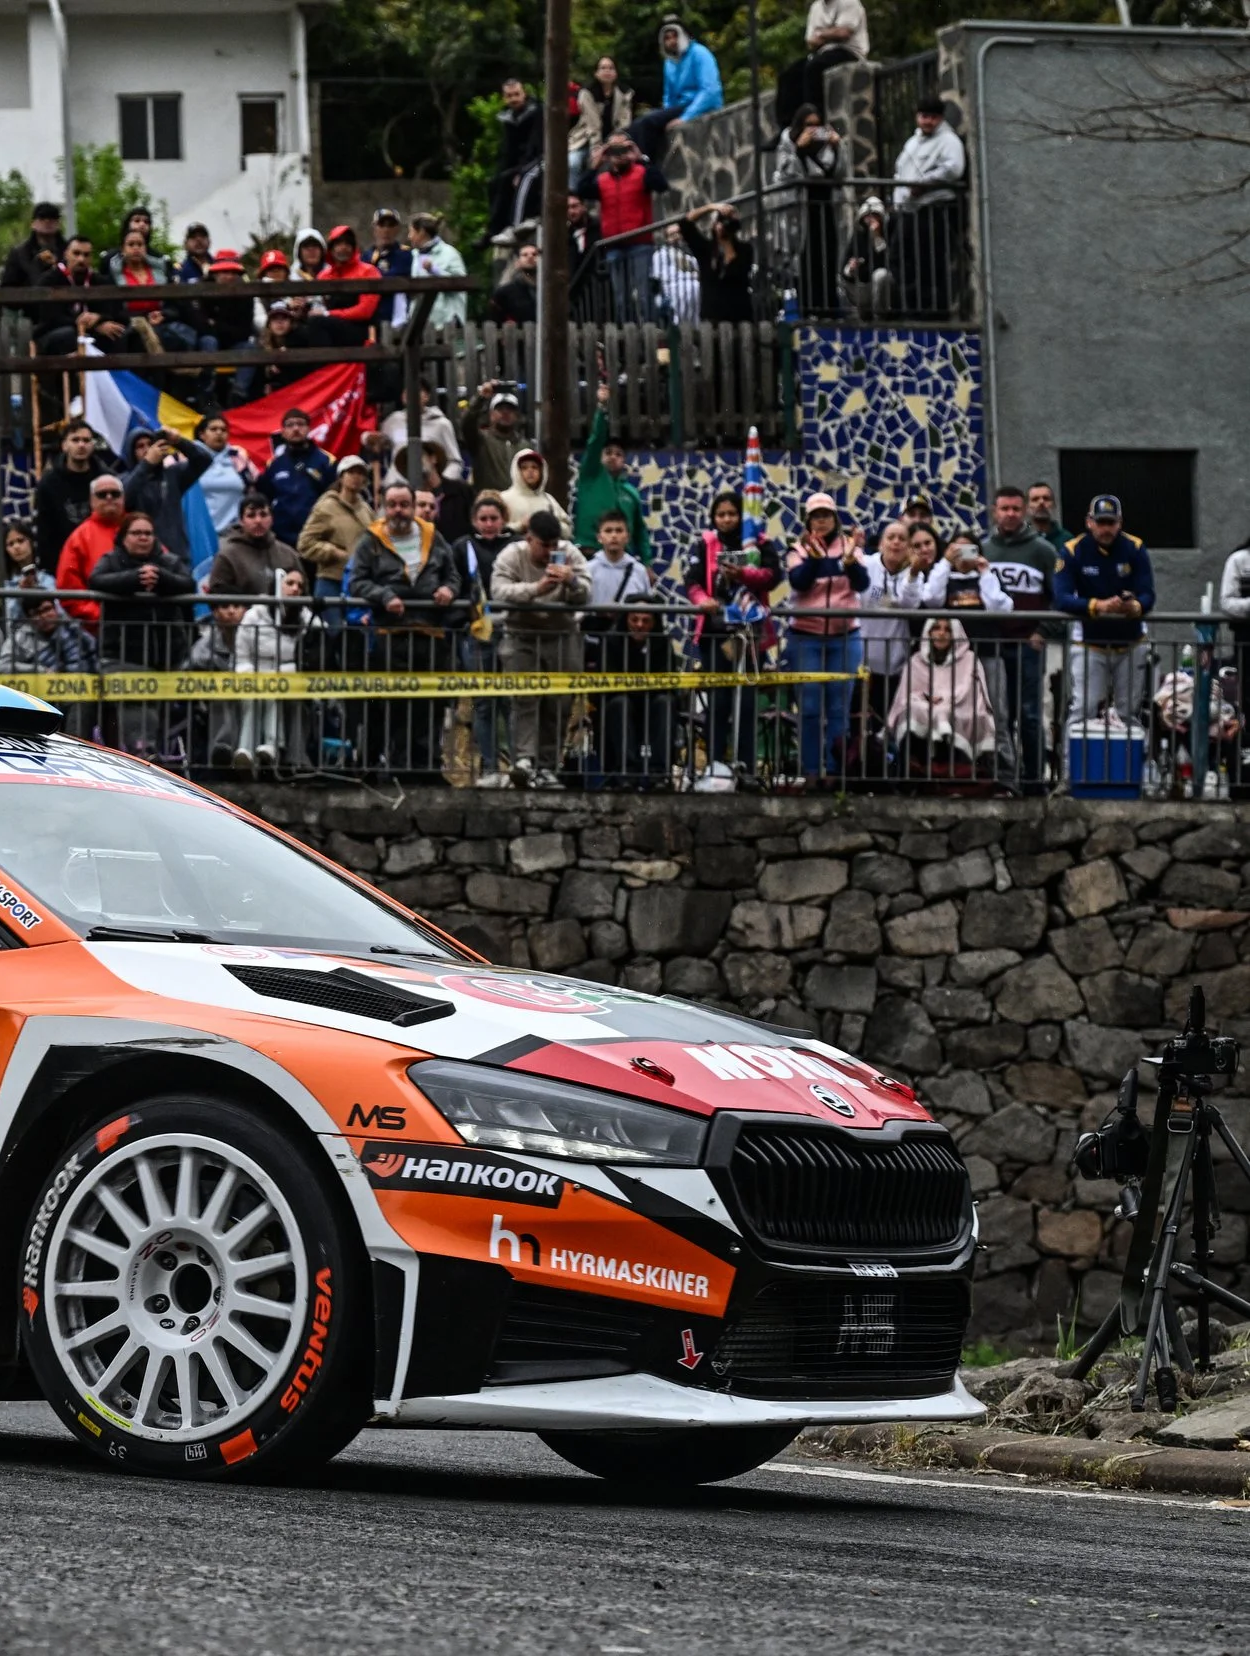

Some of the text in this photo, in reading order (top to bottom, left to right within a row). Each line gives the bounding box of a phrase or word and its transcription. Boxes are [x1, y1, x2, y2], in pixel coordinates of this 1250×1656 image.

[47, 678, 87, 695] ZONA
[93, 678, 159, 695] PUBLICO
[175, 677, 290, 694] ZONA PUBLICO
[307, 676, 420, 693] ZONA PUBLICO
[437, 674, 550, 691] ZONA PUBLICO
[568, 674, 681, 689] ZONA PUBLICO
[681, 1043, 871, 1091] MOTUL
[346, 1103, 406, 1131] MS
[551, 1247, 710, 1299] HYRMASKINER
